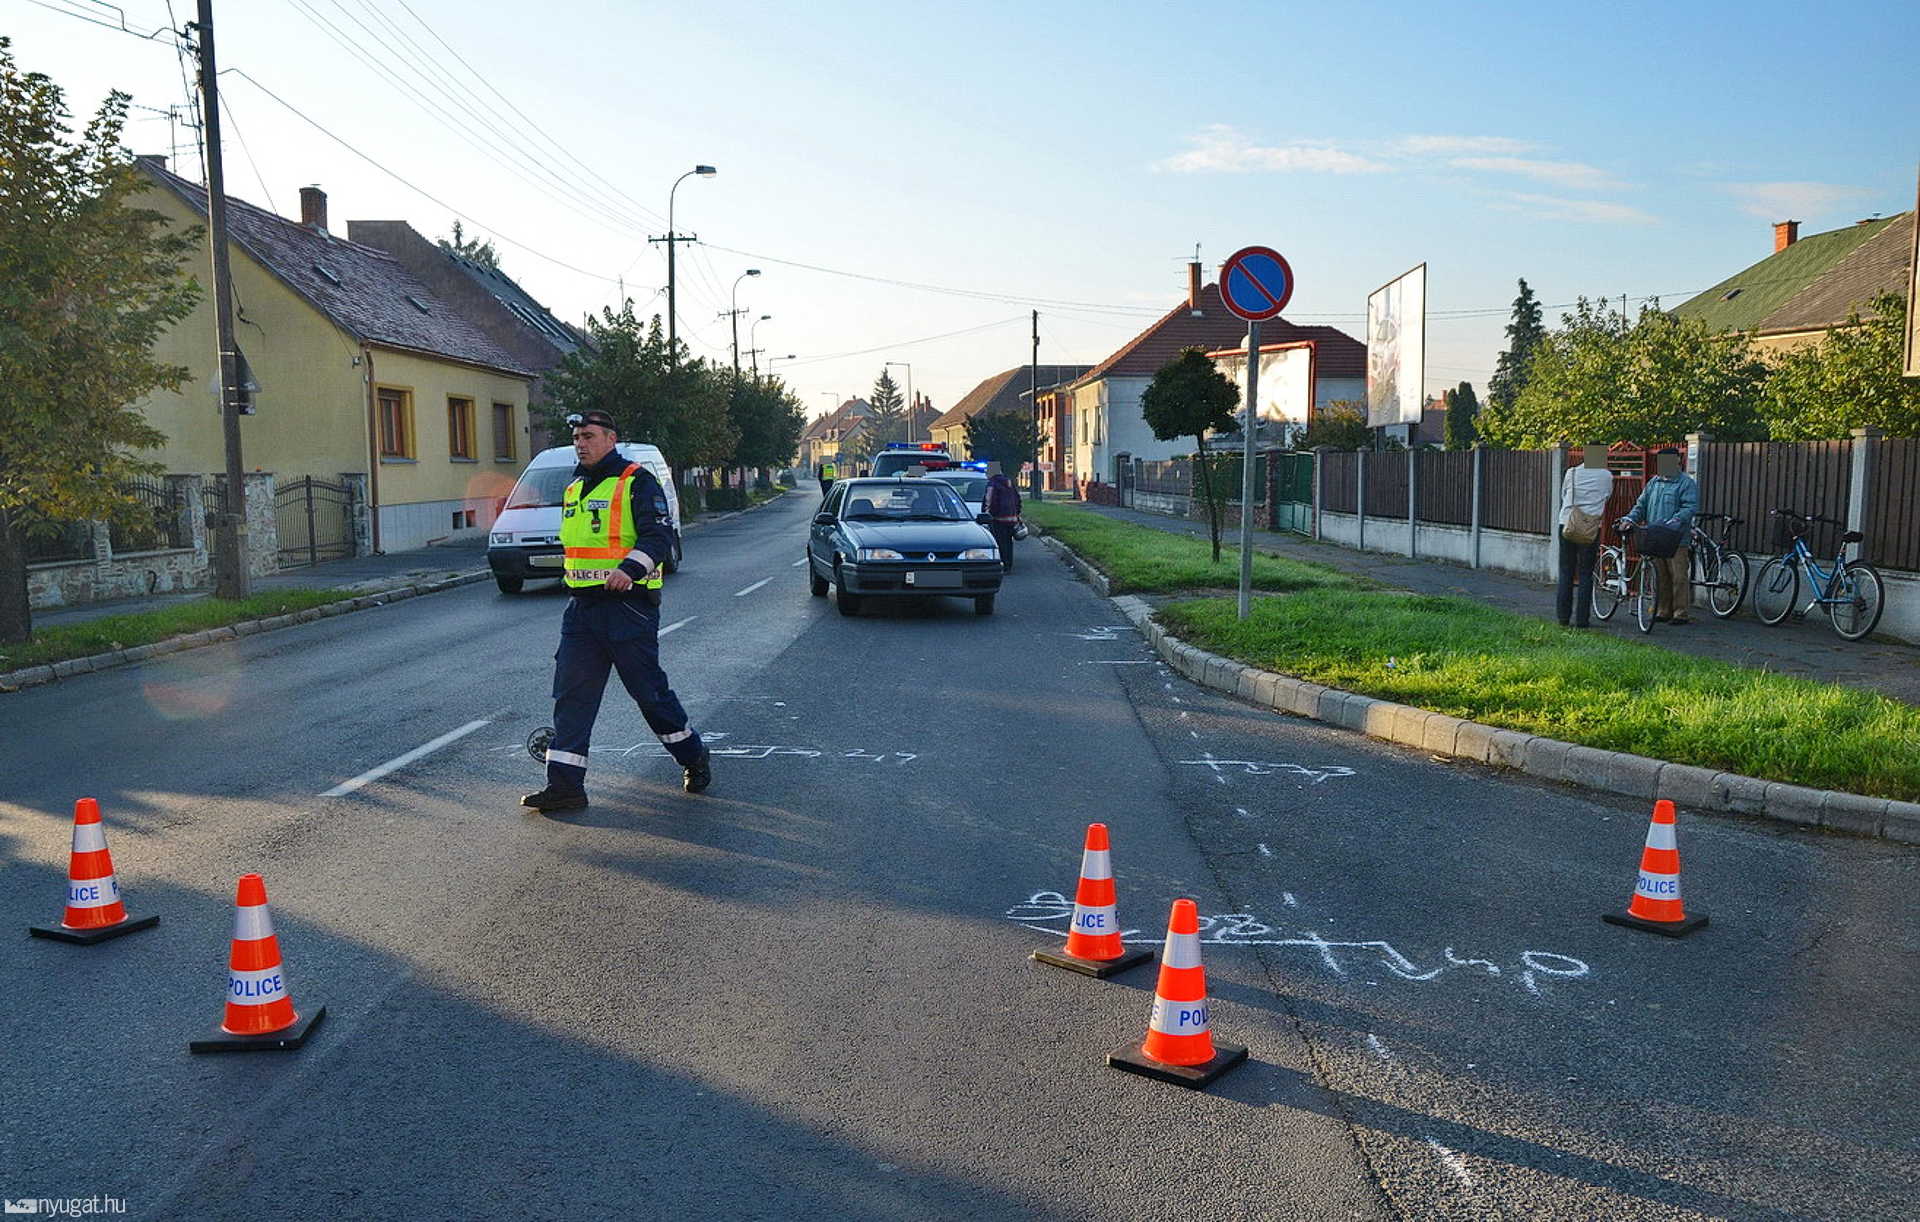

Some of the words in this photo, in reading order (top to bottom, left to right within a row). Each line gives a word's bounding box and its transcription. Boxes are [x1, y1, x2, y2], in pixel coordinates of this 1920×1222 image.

[69, 886, 99, 901] LICE
[1073, 911, 1105, 928] LICE
[1180, 1008, 1208, 1027] POL
